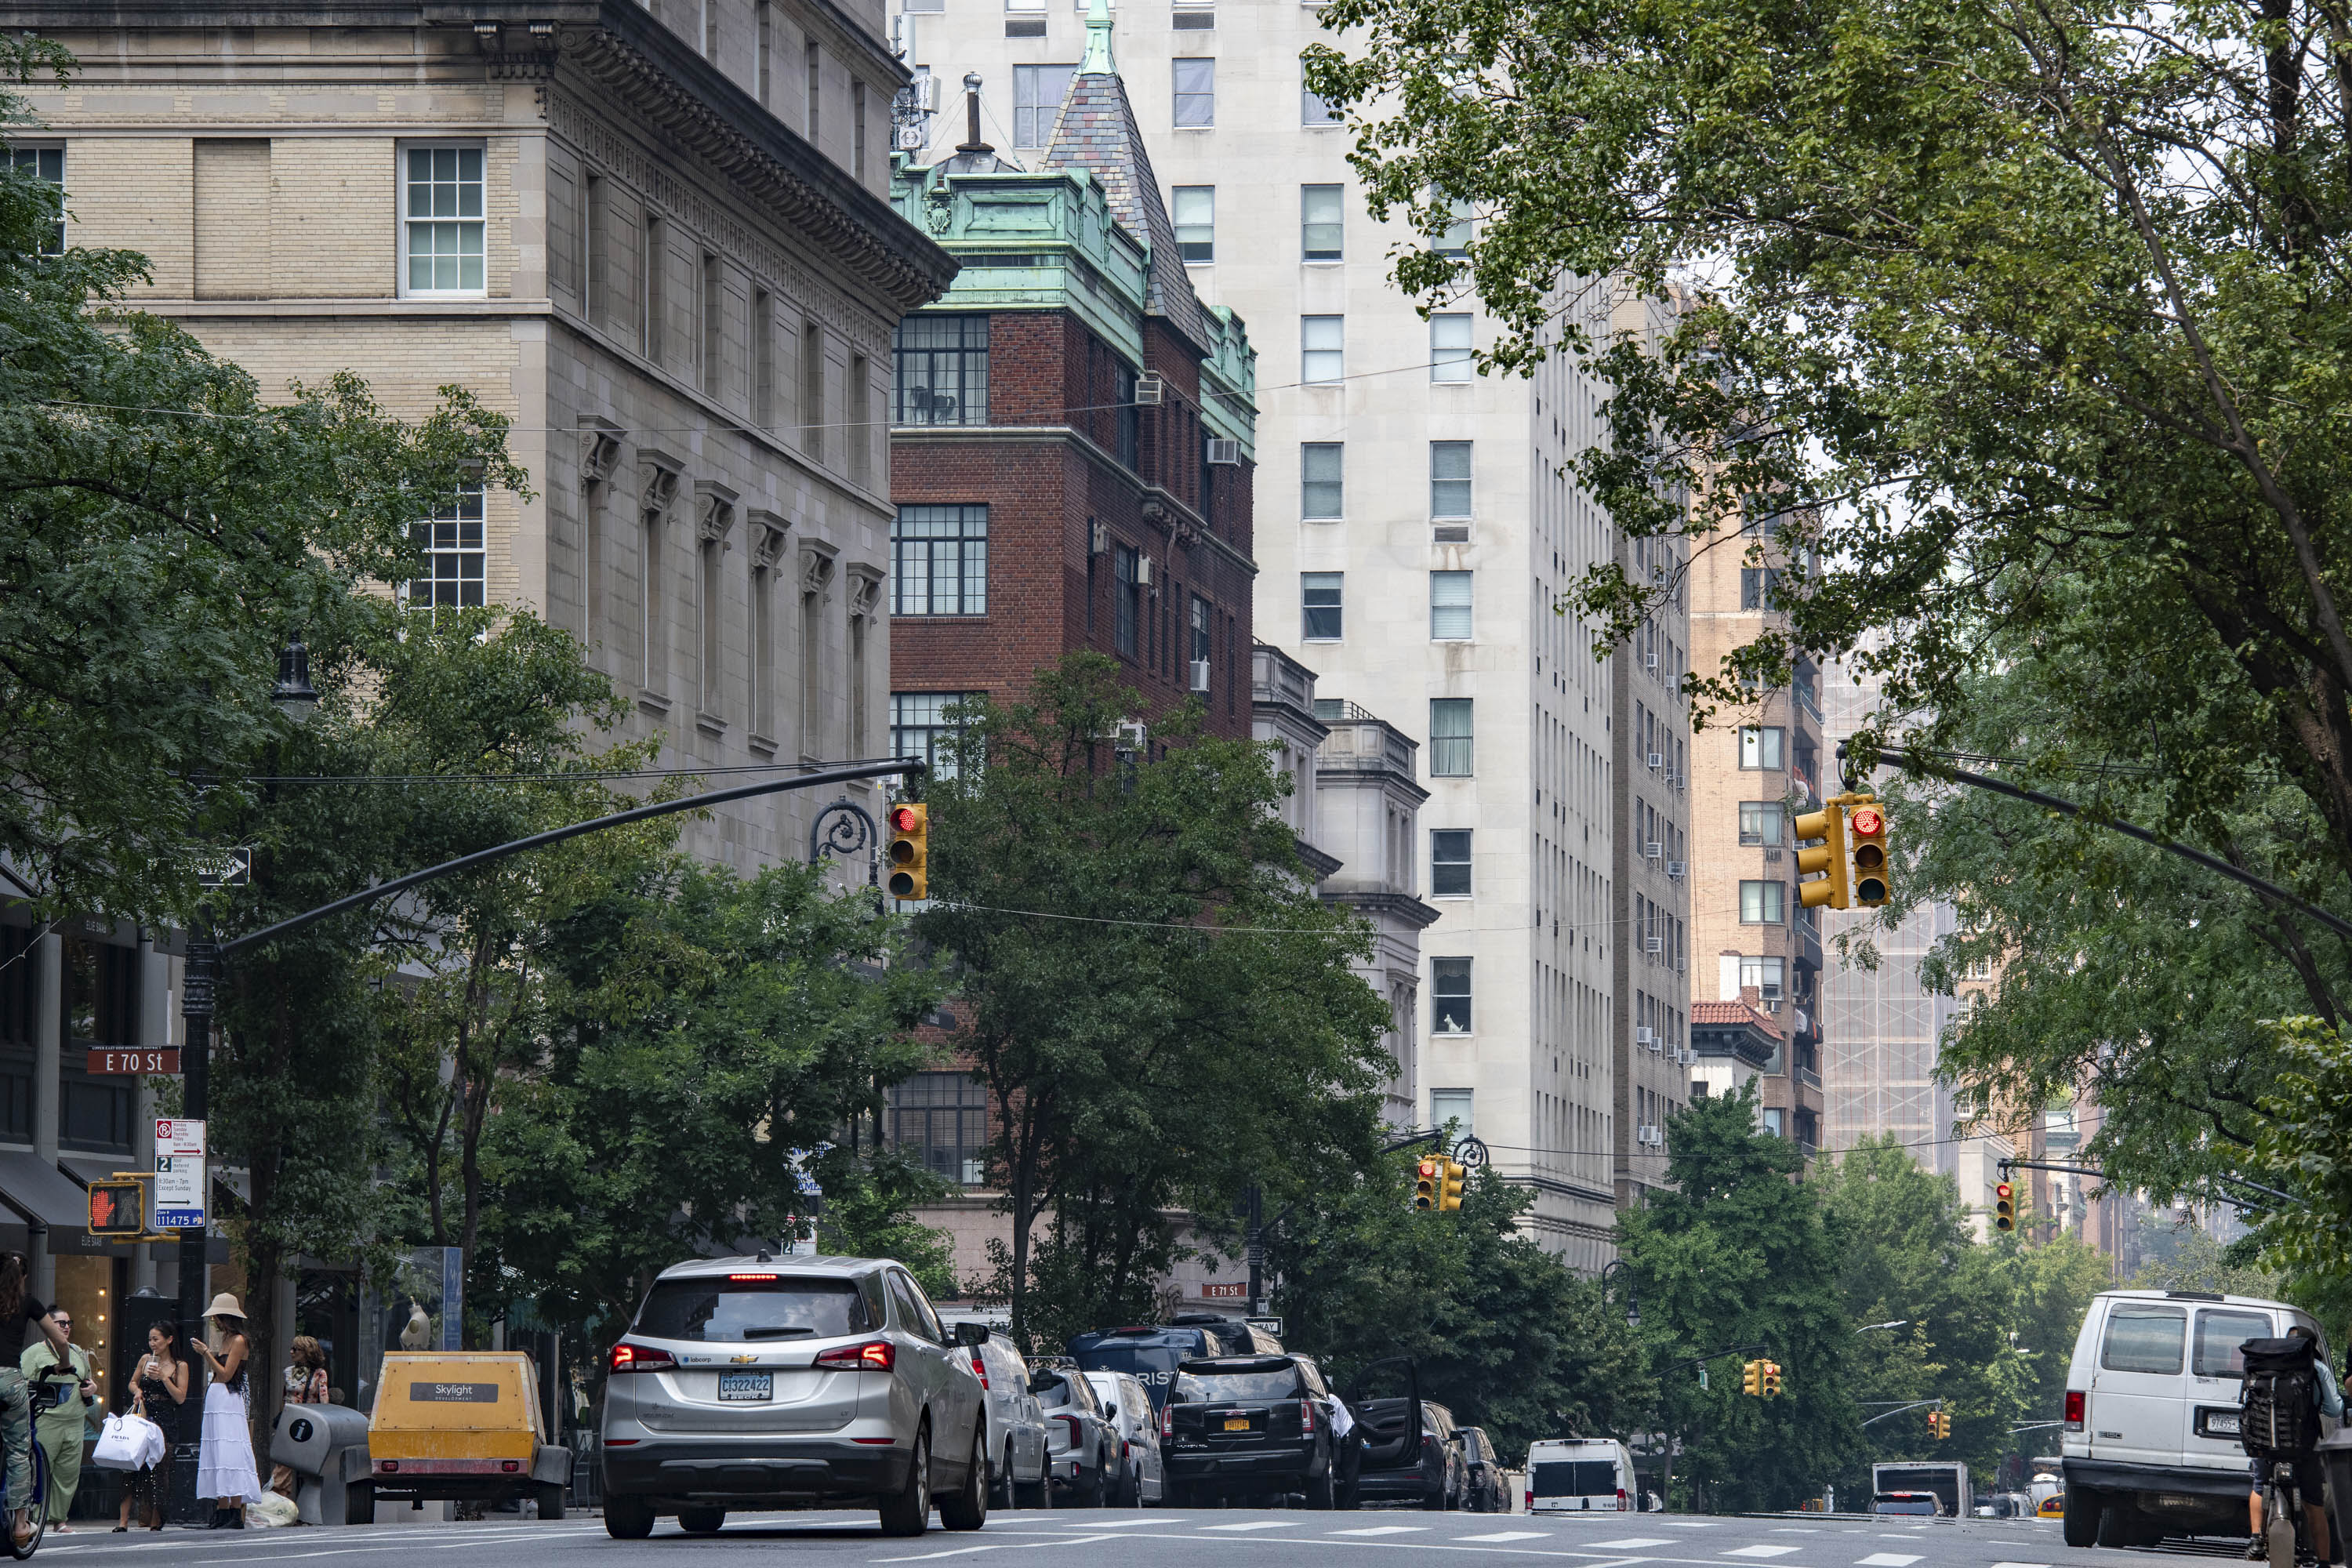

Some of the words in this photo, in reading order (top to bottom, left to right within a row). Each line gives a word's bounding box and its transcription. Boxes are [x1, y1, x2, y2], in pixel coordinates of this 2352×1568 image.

[107, 1054, 114, 1071] E
[121, 1054, 140, 1071] 70
[147, 1053, 162, 1071] St
[160, 1157, 169, 1171] 2
[158, 1216, 190, 1225] 111475
[1211, 1287, 1216, 1296] E
[1219, 1287, 1227, 1296] 71
[1229, 1286, 1238, 1296] St
[435, 1385, 473, 1396] Skylight
